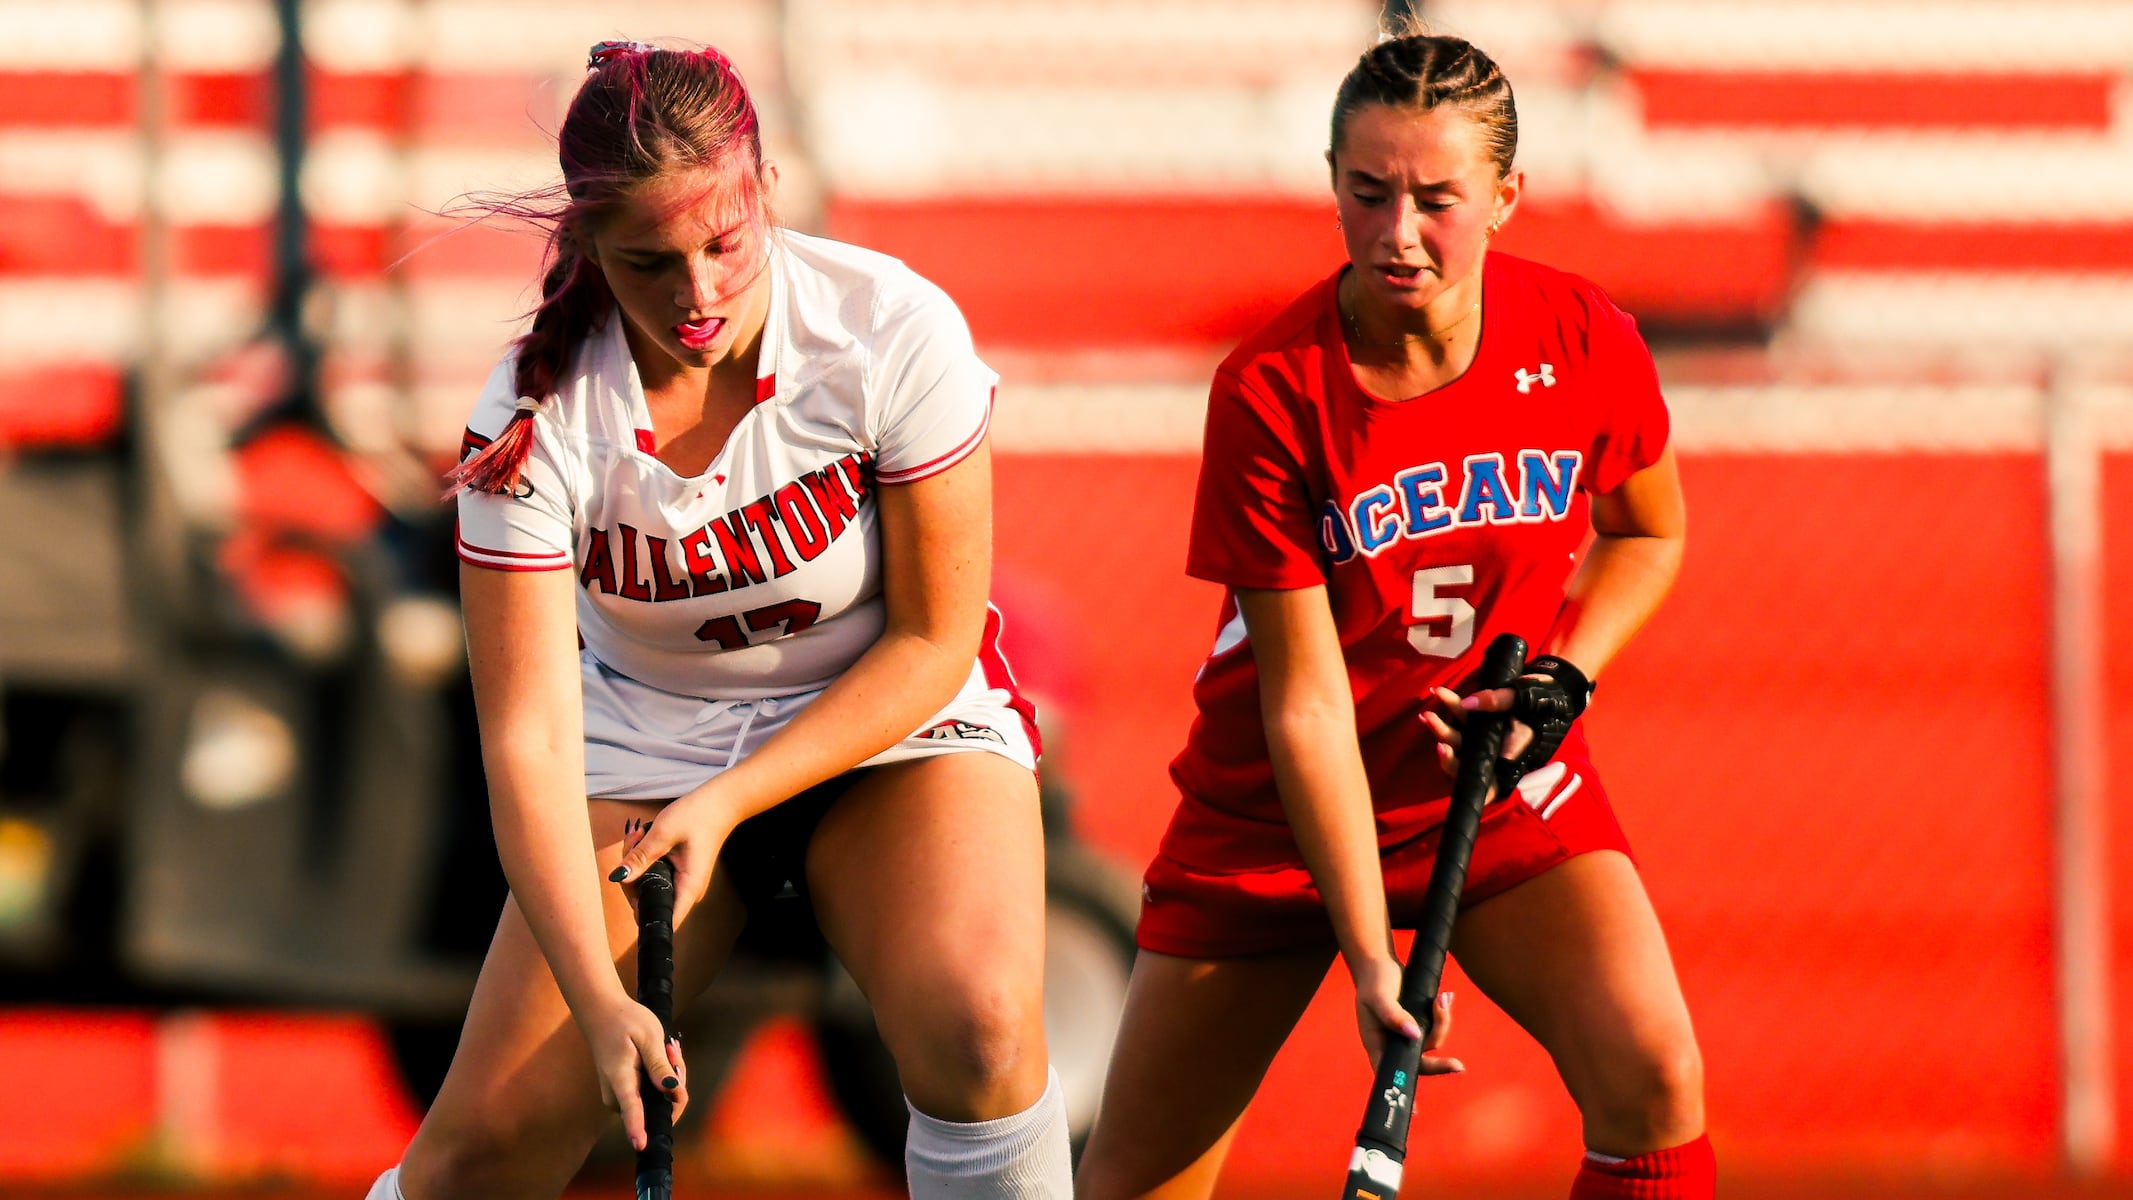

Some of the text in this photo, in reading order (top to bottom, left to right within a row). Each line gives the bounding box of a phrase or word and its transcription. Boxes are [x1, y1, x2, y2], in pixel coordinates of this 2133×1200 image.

[1317, 449, 1582, 564] OCEAN
[1407, 564, 1476, 659] 5
[1393, 1069, 1407, 1086] 55
